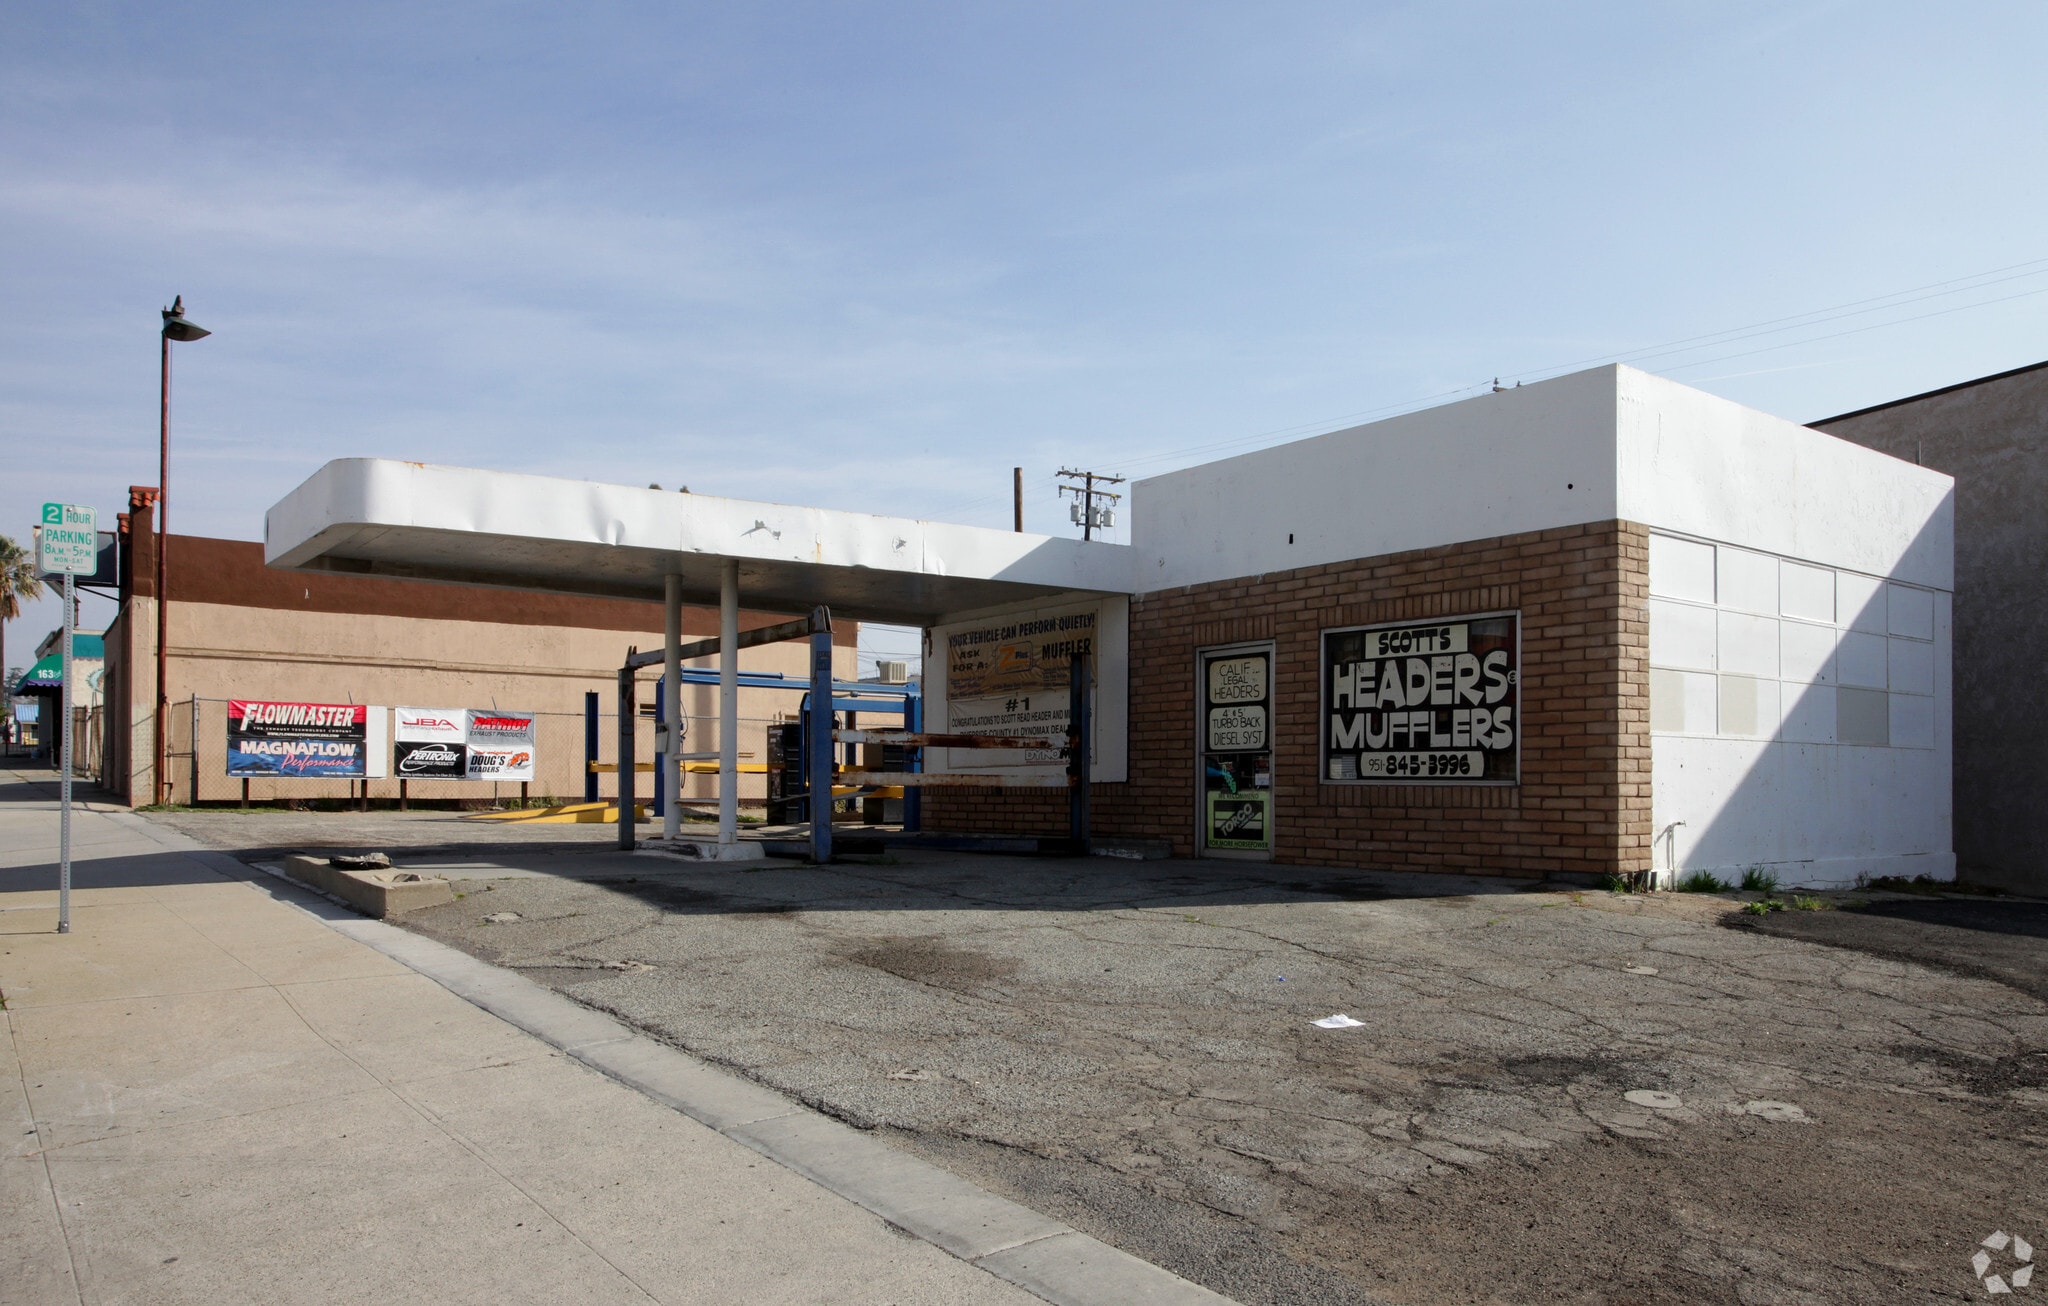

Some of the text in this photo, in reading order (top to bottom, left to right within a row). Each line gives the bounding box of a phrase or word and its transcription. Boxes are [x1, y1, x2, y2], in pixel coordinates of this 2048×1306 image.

[47, 506, 91, 524] 2 HOUR
[46, 528, 92, 545] PARKING
[54, 556, 84, 565] MON-SAT
[949, 613, 1095, 648] YOUR VEHICLE CAN PERFORM QUIETLY!
[959, 649, 980, 660] ASK
[1042, 638, 1091, 660] MUFFLER
[37, 669, 54, 679] 163
[953, 663, 974, 672] FOR
[1223, 676, 1248, 685] LEGAL
[1333, 650, 1509, 710] HEADERS
[1214, 684, 1260, 699] HEADERS
[1005, 697, 1030, 712] #1
[240, 704, 355, 731] FLOWMASTER
[402, 718, 459, 730] JBA
[472, 716, 532, 731] PATRIOT
[952, 716, 994, 728] CONGRATULATIONS
[994, 715, 1000, 724] TO
[1001, 713, 1016, 724] SCOTT
[1031, 710, 1052, 721] HEADER
[1053, 709, 1064, 719] AND
[1212, 717, 1261, 729] TURBO BACK
[1020, 725, 1049, 736] DYNOMAX
[1331, 706, 1513, 750] MUFFLERS
[1214, 731, 1263, 746] DIESEL SYST
[240, 741, 356, 757] MAGNAFLOW
[281, 752, 355, 772] Performance
[471, 755, 506, 766] DOUG'S
[1221, 803, 1252, 837] TORCO
